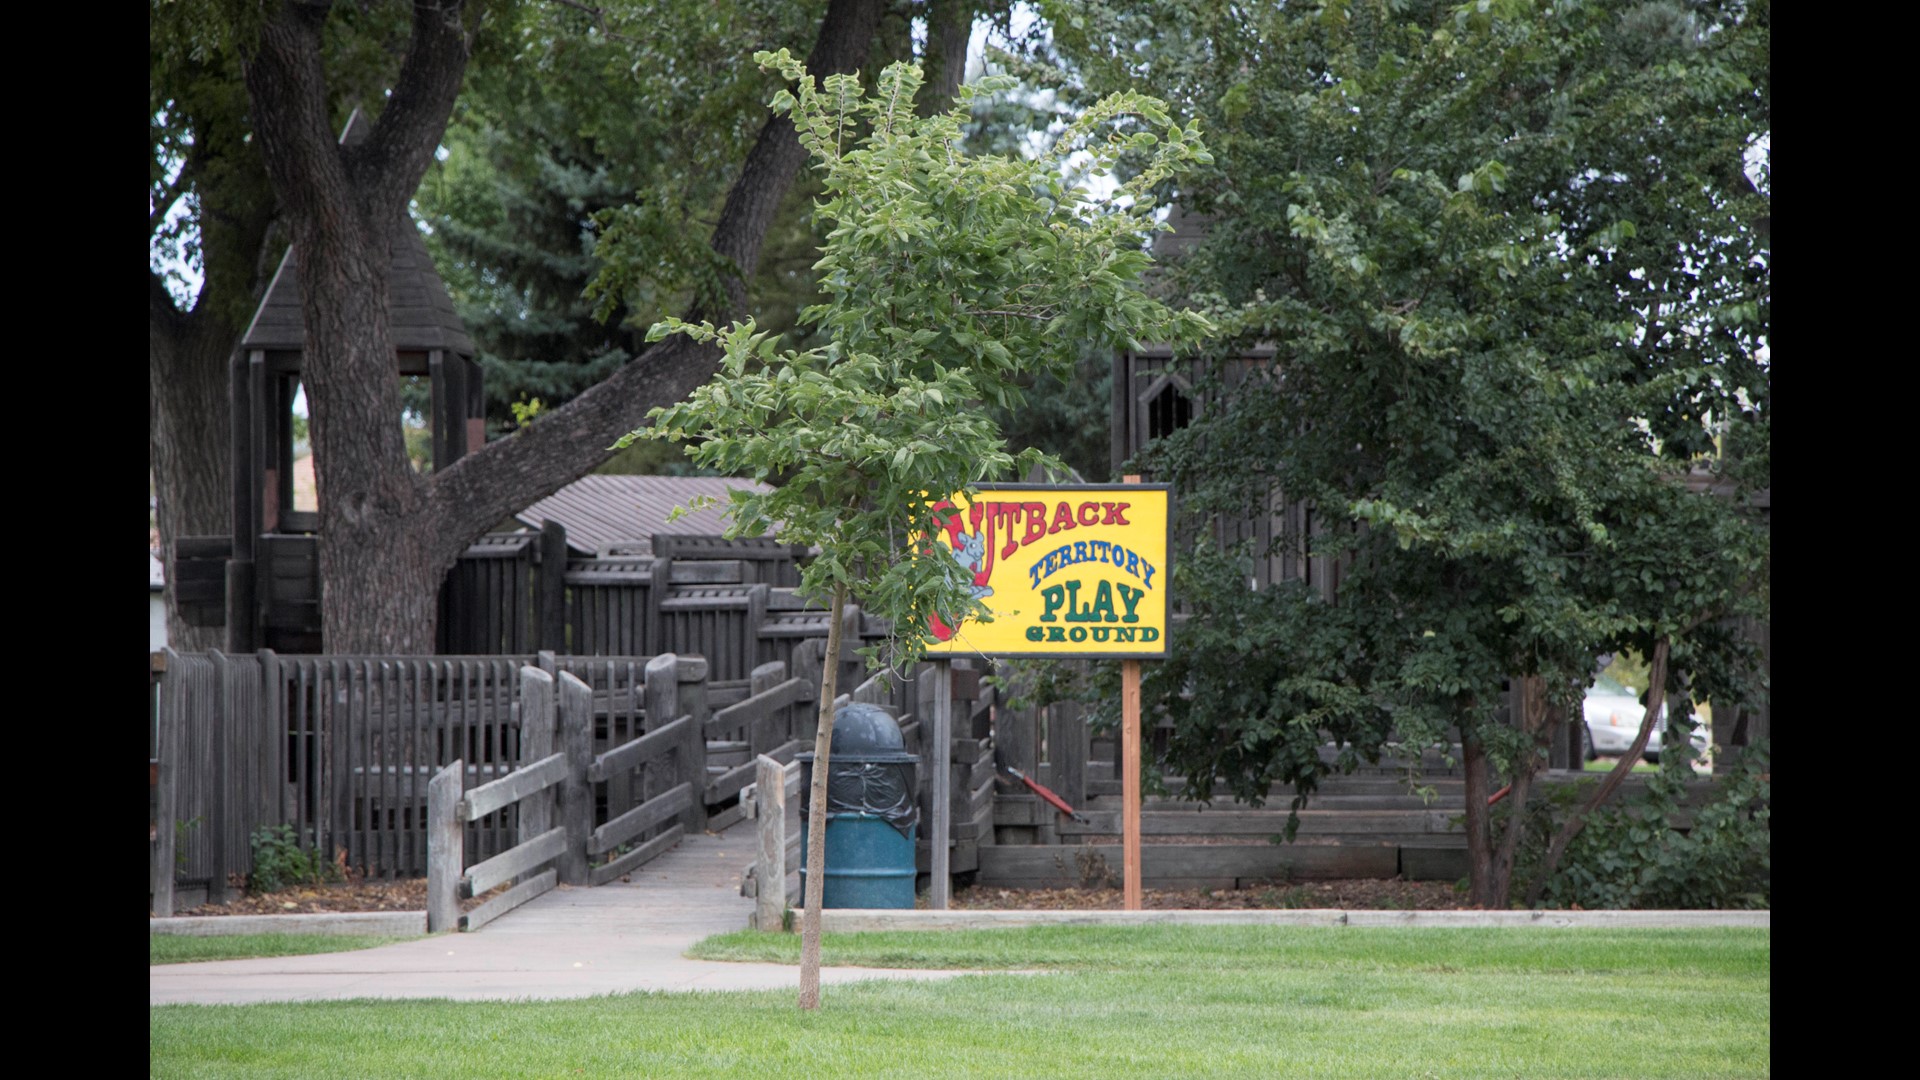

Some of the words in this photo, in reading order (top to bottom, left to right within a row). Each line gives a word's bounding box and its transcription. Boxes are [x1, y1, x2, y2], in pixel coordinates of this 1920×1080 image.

[1029, 540, 1156, 590] TERRITORY
[1040, 580, 1144, 623] PLAY
[1025, 626, 1159, 642] GROUND
